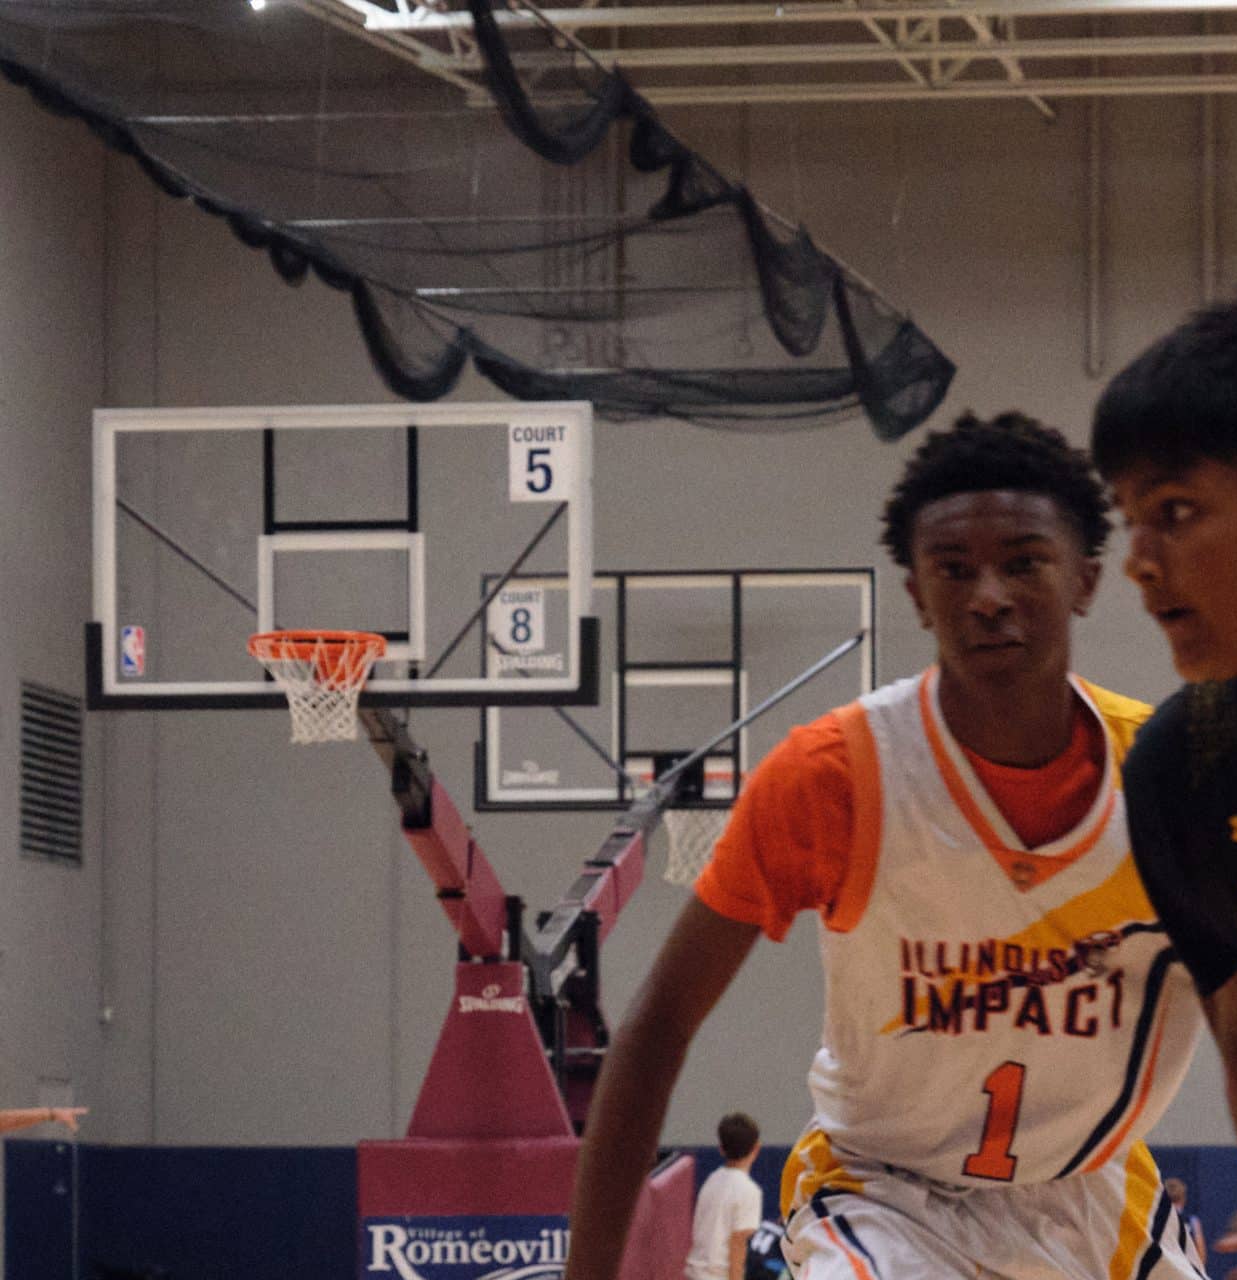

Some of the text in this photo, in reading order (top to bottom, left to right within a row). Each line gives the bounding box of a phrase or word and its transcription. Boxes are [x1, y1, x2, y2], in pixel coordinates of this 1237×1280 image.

[512, 425, 566, 443] COURT
[526, 447, 554, 494] 5
[501, 590, 542, 604] COURT
[511, 607, 532, 643] 8
[900, 938, 1069, 983] ILLINOIS
[902, 967, 1125, 1038] IMPACT
[961, 1060, 1027, 1182] 1
